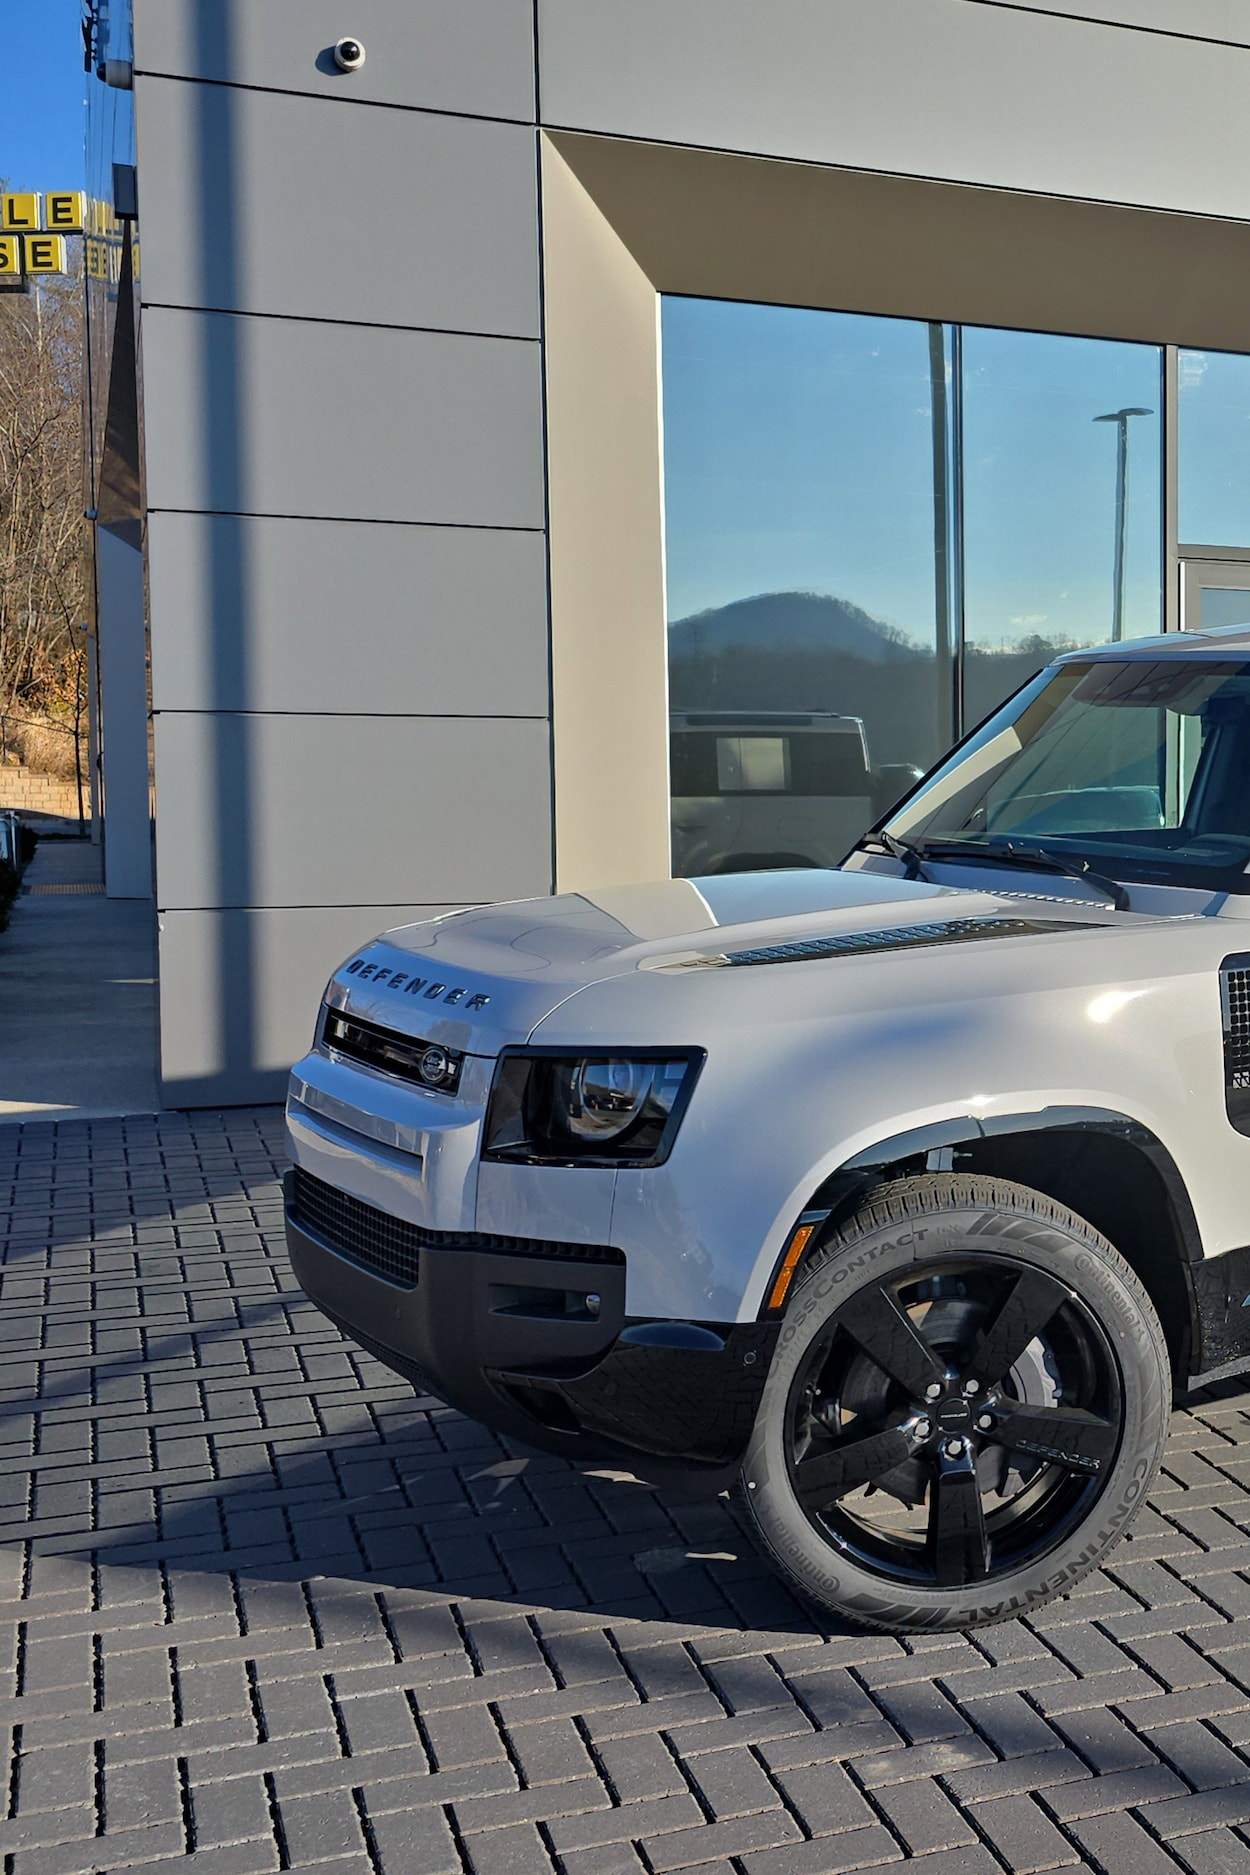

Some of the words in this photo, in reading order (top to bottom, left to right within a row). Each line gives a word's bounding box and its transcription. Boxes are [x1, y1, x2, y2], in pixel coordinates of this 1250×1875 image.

[8, 196, 73, 225] LE
[346, 959, 491, 1011] DEFENDER
[1016, 1440, 1101, 1469] DEFENDER
[959, 1458, 1148, 1621] CONTINENTAL
